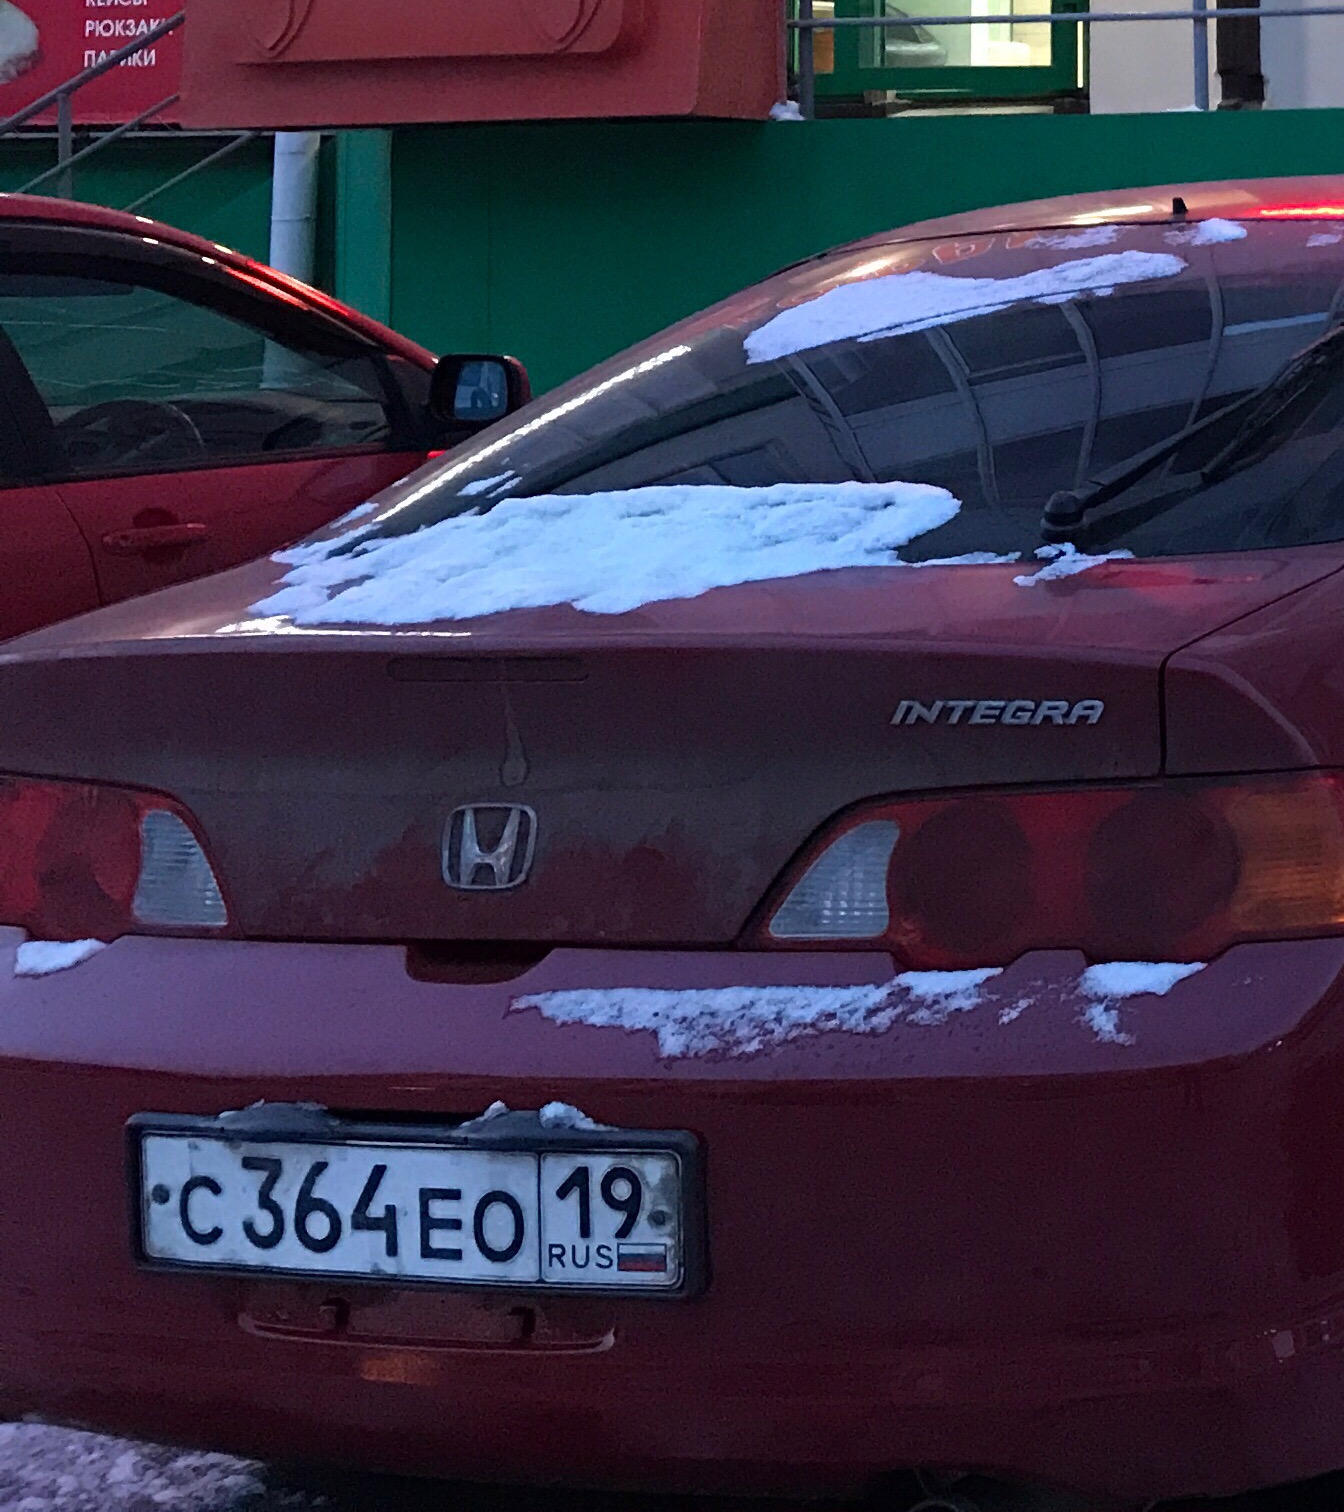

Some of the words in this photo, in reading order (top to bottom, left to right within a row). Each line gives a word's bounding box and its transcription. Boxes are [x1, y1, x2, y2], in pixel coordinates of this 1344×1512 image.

[889, 699, 1105, 726] INTEGRA
[555, 1166, 643, 1240] 19
[548, 1243, 614, 1270] RUS
